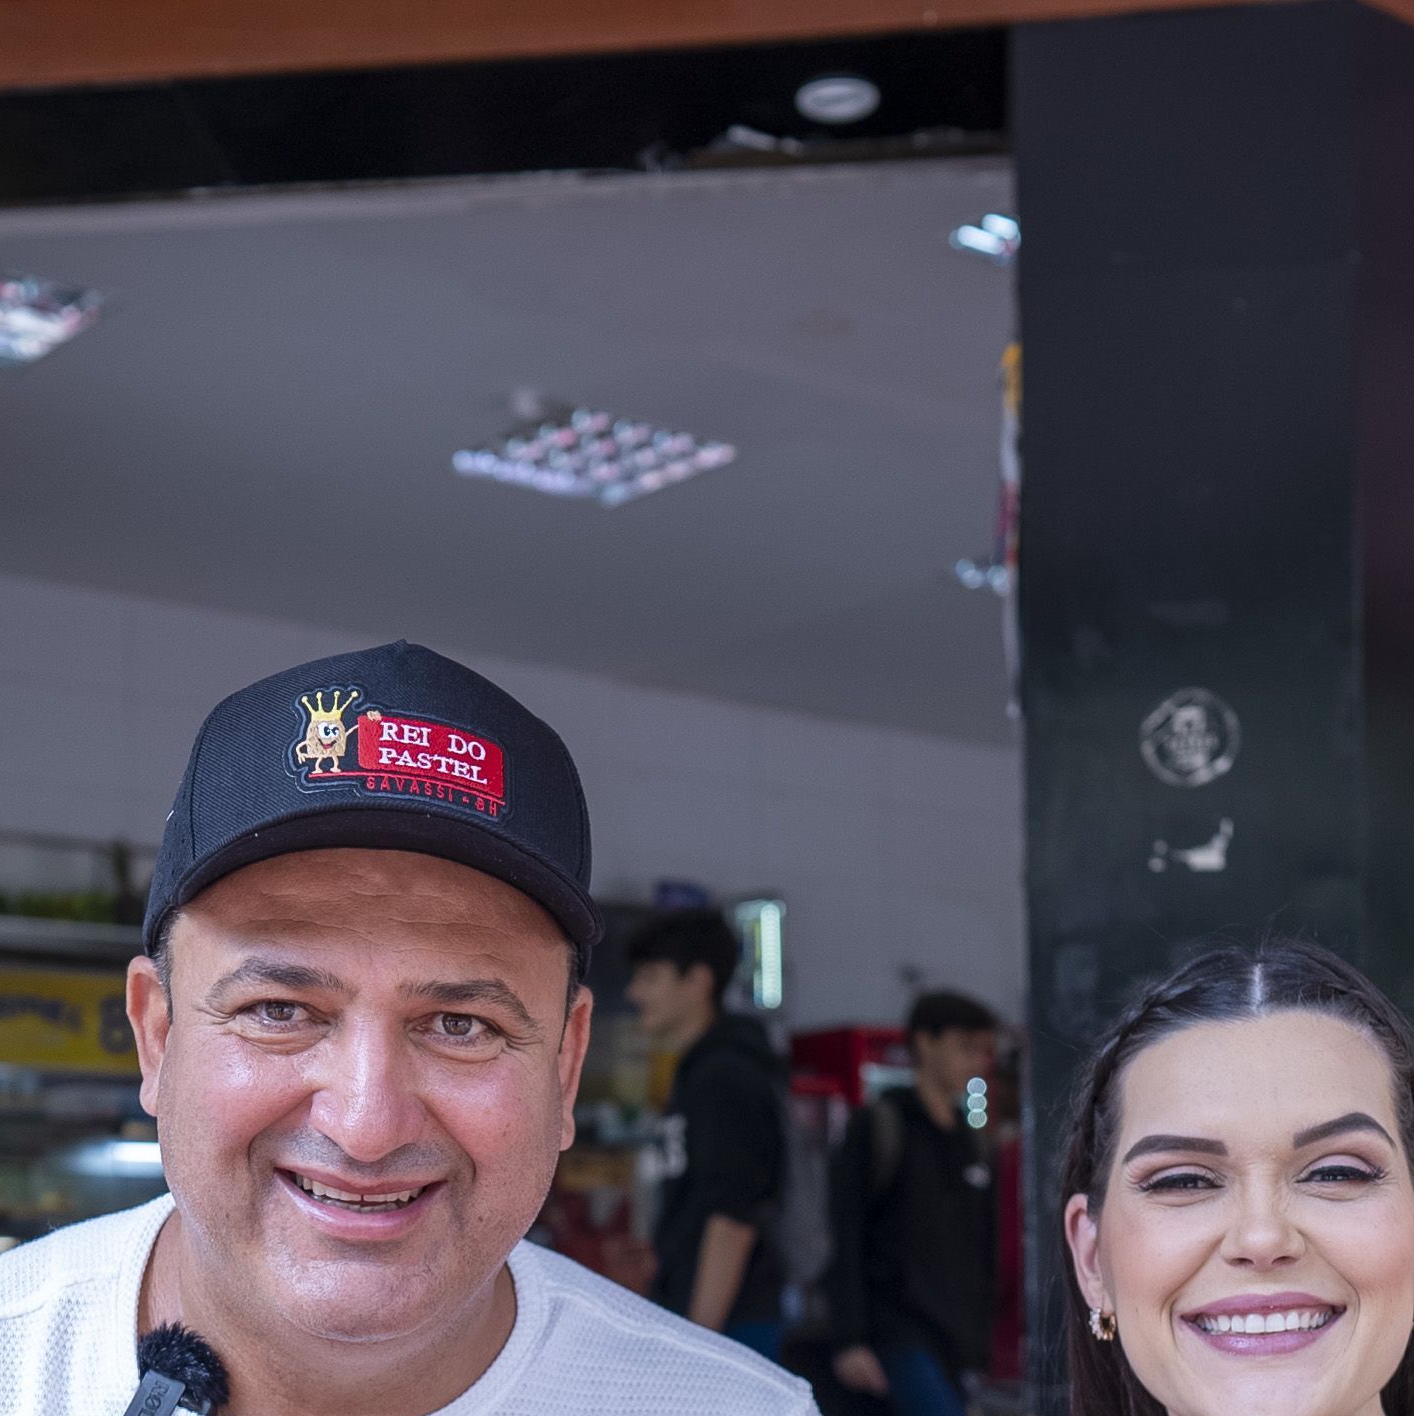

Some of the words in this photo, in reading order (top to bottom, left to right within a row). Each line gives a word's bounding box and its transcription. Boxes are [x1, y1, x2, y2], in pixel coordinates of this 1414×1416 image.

[379, 721, 432, 748] REI
[447, 733, 487, 761] DO
[378, 746, 488, 785] PASTEL
[366, 775, 454, 802] SAVASSI
[474, 796, 498, 817] BH
